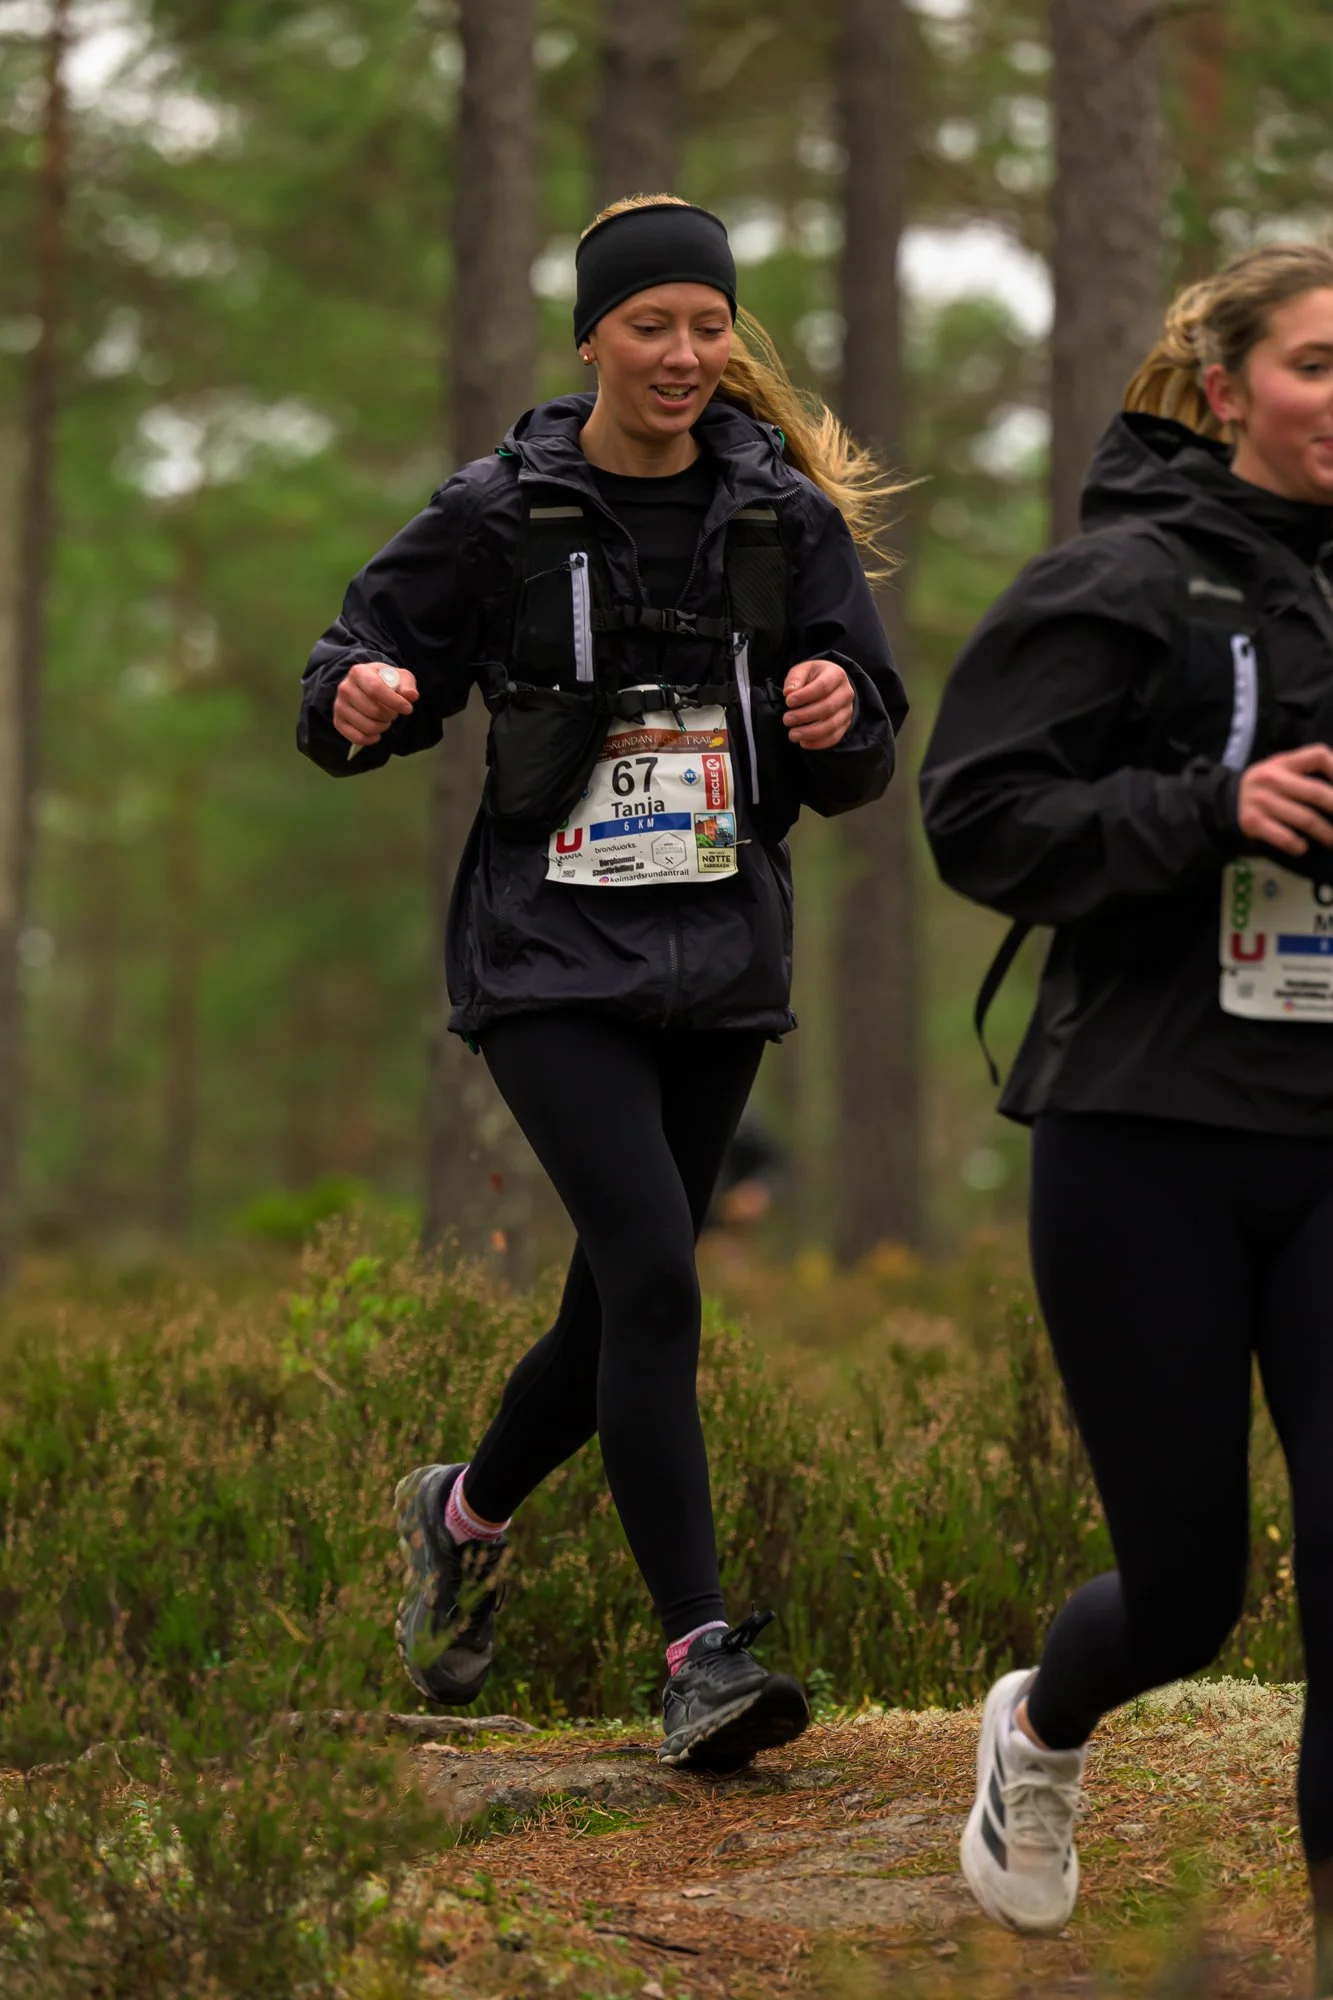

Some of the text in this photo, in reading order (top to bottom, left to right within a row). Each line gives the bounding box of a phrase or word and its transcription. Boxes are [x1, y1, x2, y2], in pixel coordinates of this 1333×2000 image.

[683, 735, 713, 746] TRAIL
[611, 756, 659, 797] 67
[710, 771, 721, 806] CIRCLE
[610, 796, 666, 819] Tanja
[623, 821, 630, 832] 6
